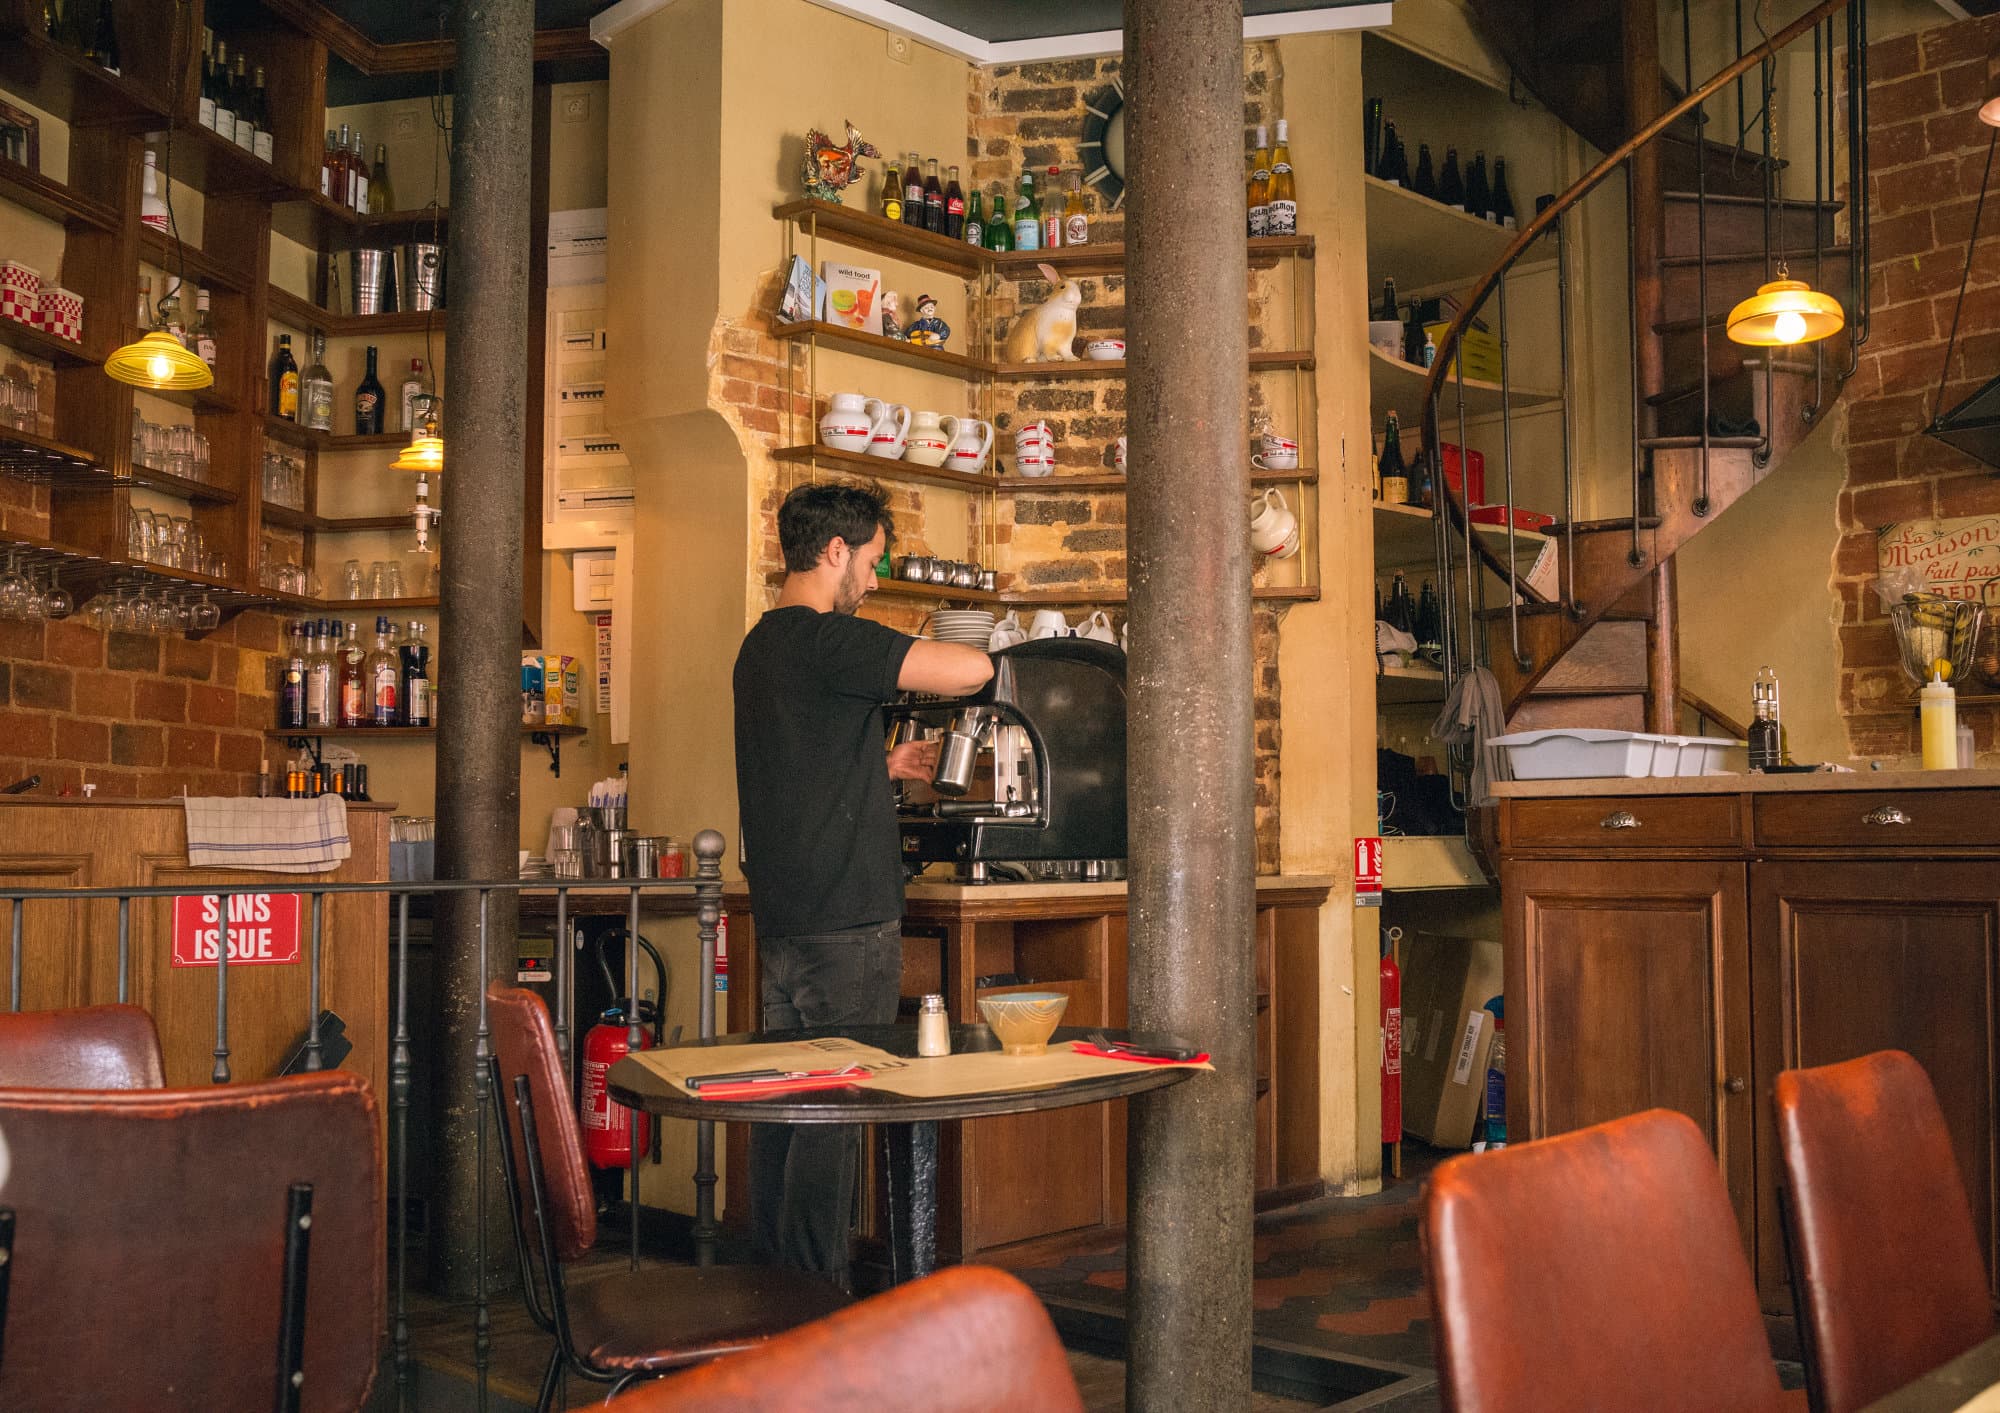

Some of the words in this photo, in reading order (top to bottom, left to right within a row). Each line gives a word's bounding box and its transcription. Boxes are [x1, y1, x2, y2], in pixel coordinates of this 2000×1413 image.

[838, 268, 853, 277] wild
[854, 271, 870, 279] food
[1881, 527, 1996, 568] Maison
[1902, 527, 1925, 545] La
[201, 893, 271, 923] SANS
[194, 928, 272, 960] ISSUE
